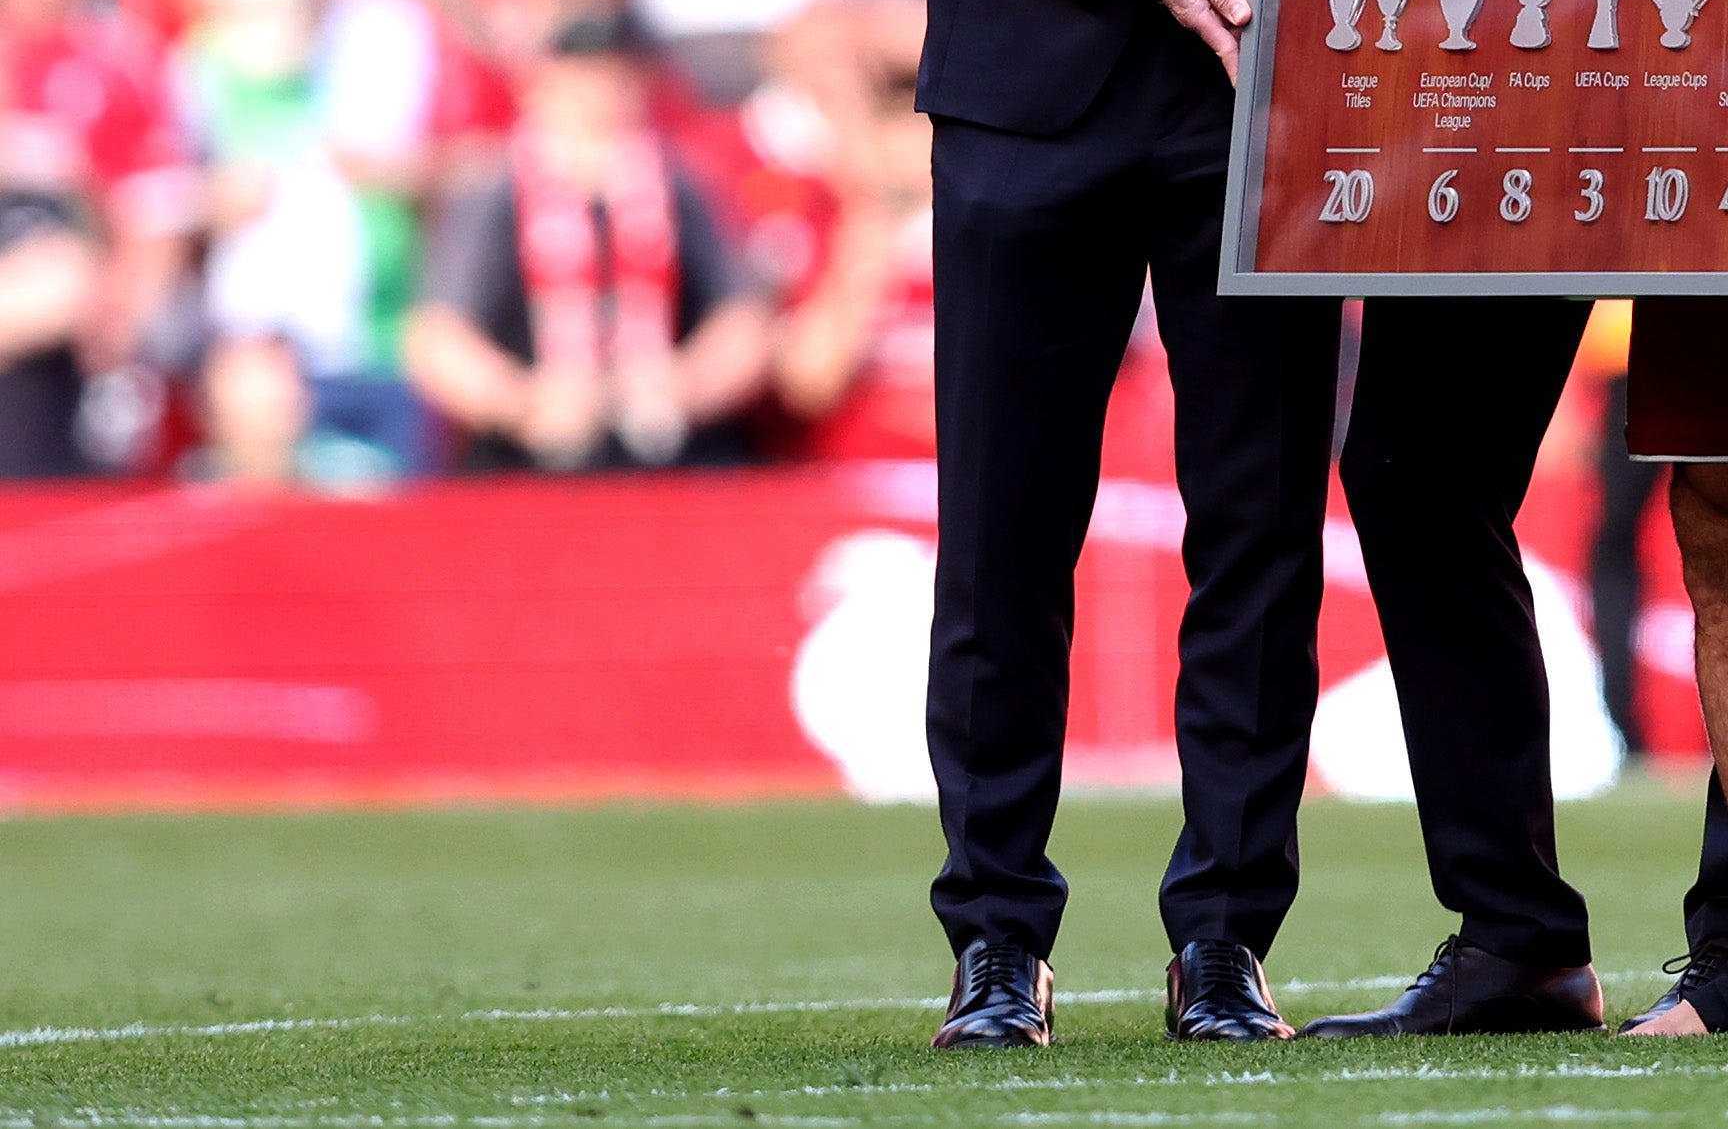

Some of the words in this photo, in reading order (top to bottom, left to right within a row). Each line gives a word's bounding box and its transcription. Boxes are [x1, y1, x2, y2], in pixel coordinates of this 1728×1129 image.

[1341, 72, 1378, 90] League
[1420, 72, 1466, 91] European
[1468, 72, 1493, 90] Cup/
[1508, 72, 1522, 87] FA
[1524, 72, 1550, 90] Cups
[1575, 71, 1601, 86] UEFA
[1603, 71, 1629, 90] Cups
[1643, 71, 1679, 89] League
[1681, 72, 1707, 89] Cups
[1344, 92, 1371, 107] Titles
[1412, 92, 1439, 107] UEFA
[1441, 91, 1496, 111] Champions
[1435, 112, 1471, 131] League
[1318, 168, 1375, 221] 20
[1427, 169, 1459, 221] 6
[1499, 168, 1533, 221] 8
[1573, 168, 1604, 221] 3
[1643, 166, 1689, 221] 10
